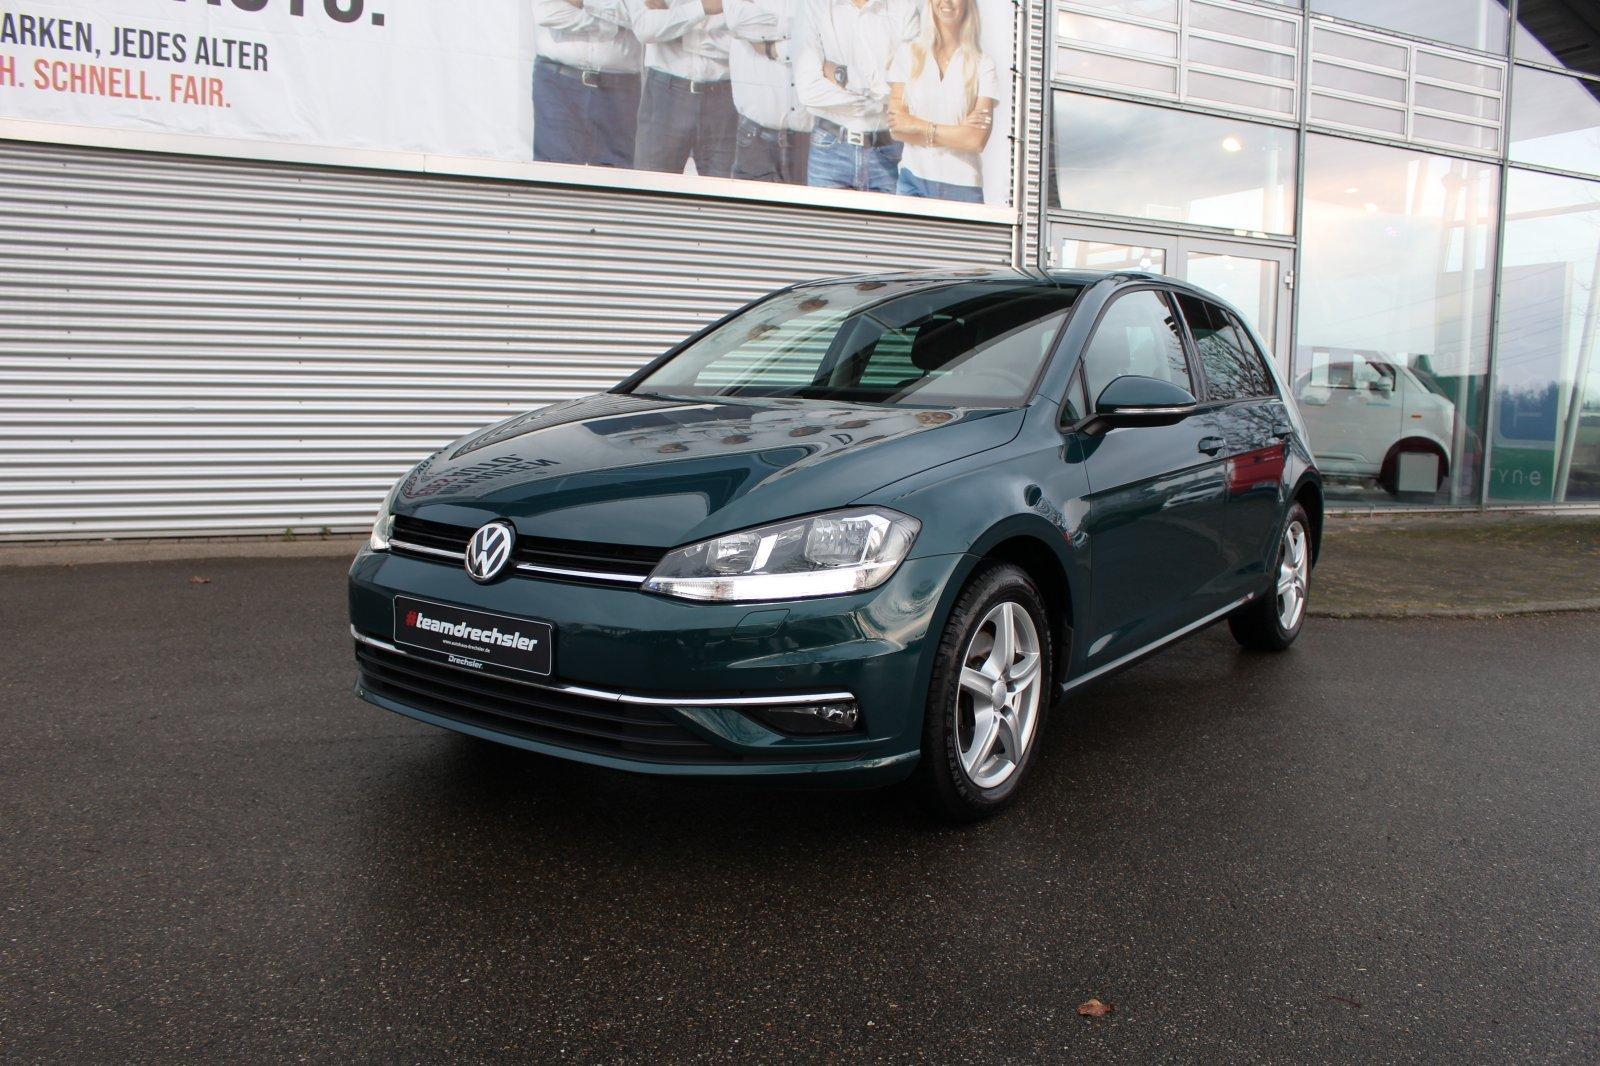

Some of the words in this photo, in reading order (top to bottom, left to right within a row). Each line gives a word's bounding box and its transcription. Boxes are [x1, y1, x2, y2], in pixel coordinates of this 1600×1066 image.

[0, 12, 101, 59] ARKEN,
[110, 26, 187, 63] JEDES
[194, 35, 268, 72] ALTER
[33, 58, 161, 101] SCHNELL.
[170, 73, 231, 108] FAIR.
[404, 609, 538, 652] #teamdrechsler
